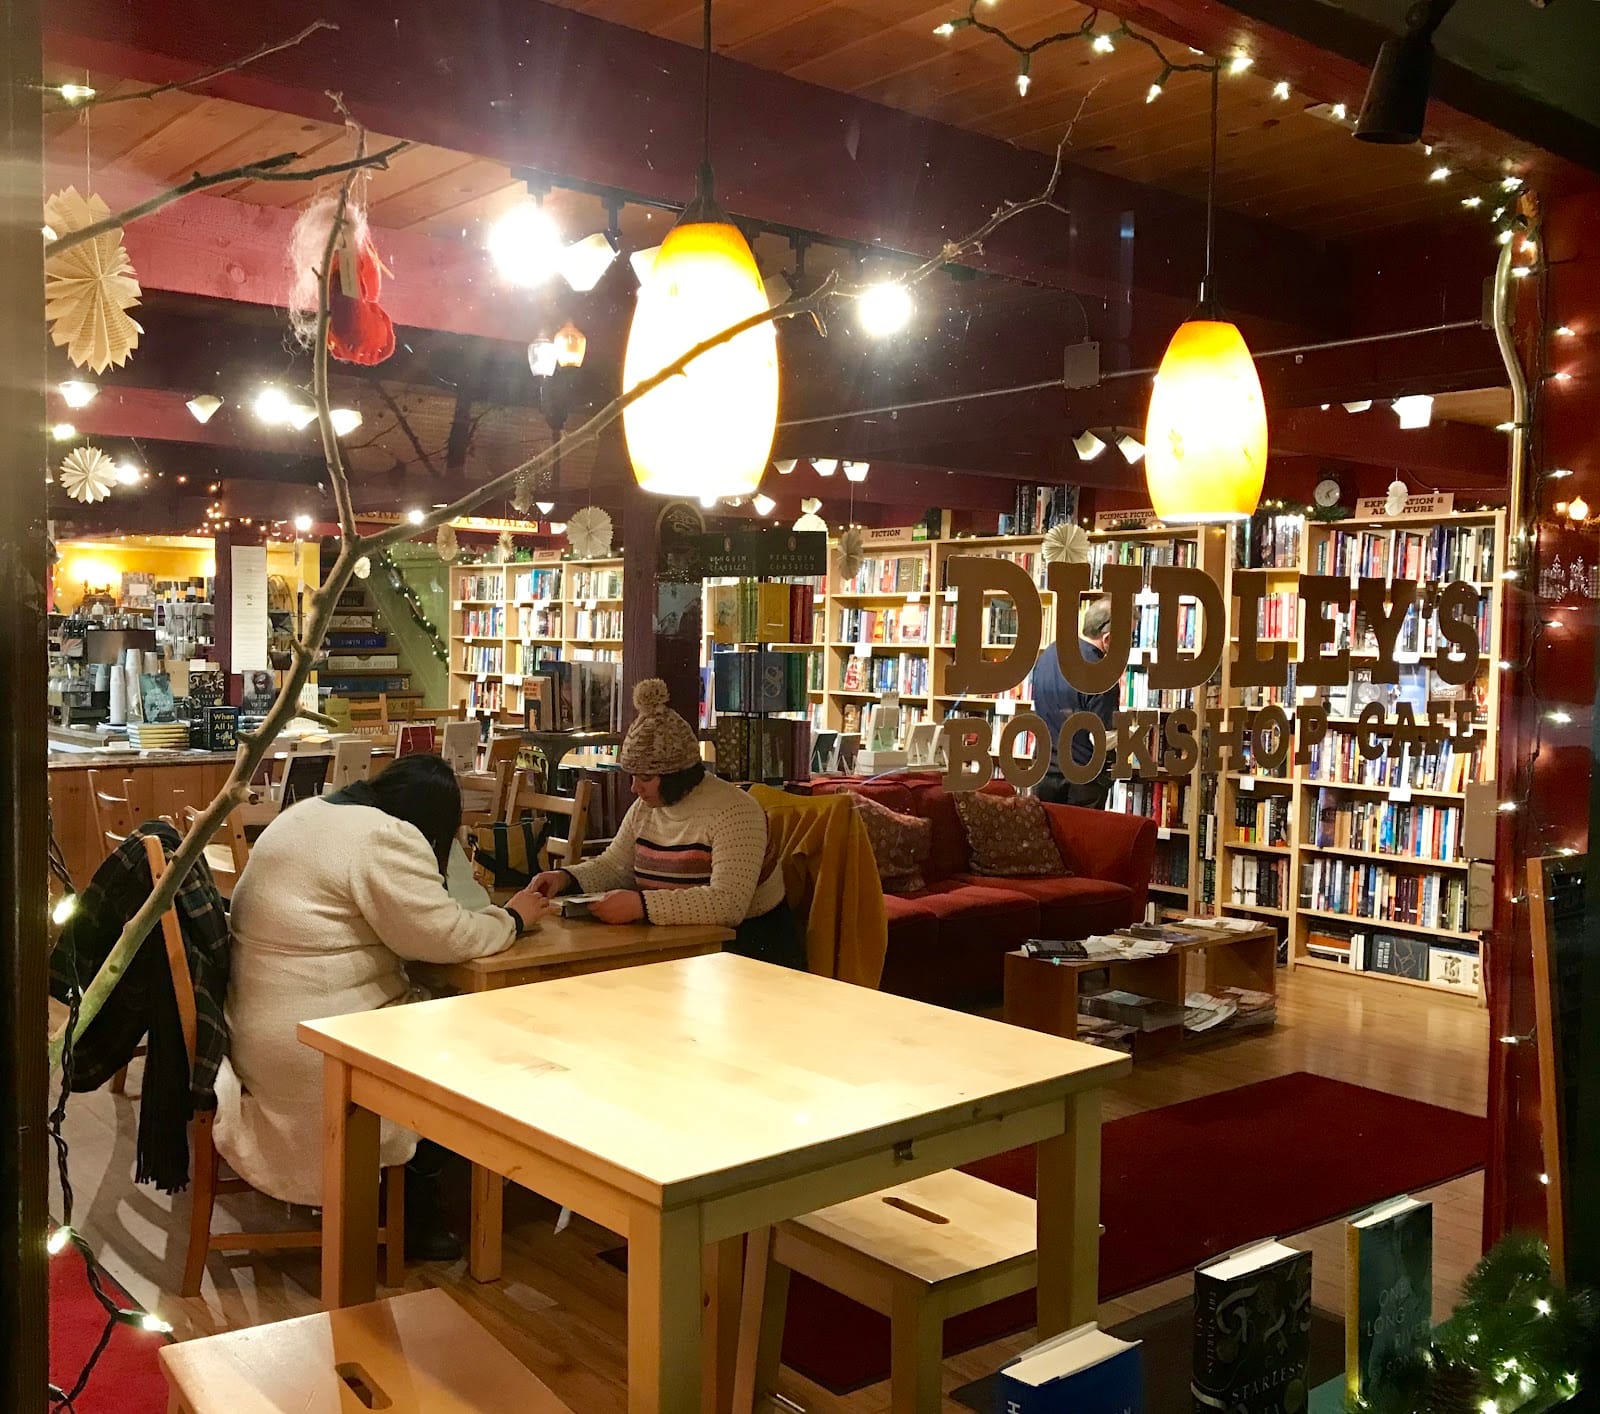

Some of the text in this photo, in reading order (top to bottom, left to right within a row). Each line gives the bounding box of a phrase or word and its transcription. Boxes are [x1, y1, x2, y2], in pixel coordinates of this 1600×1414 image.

[1099, 512, 1128, 520] SCIENCE
[870, 529, 901, 538] FICTION
[944, 555, 1480, 696] DUDLEY'S
[213, 713, 235, 721] When
[942, 700, 1477, 792] BOOKSHOP CAFE
[1367, 1306, 1406, 1337] LONG
[1232, 1360, 1305, 1401] STARLESS
